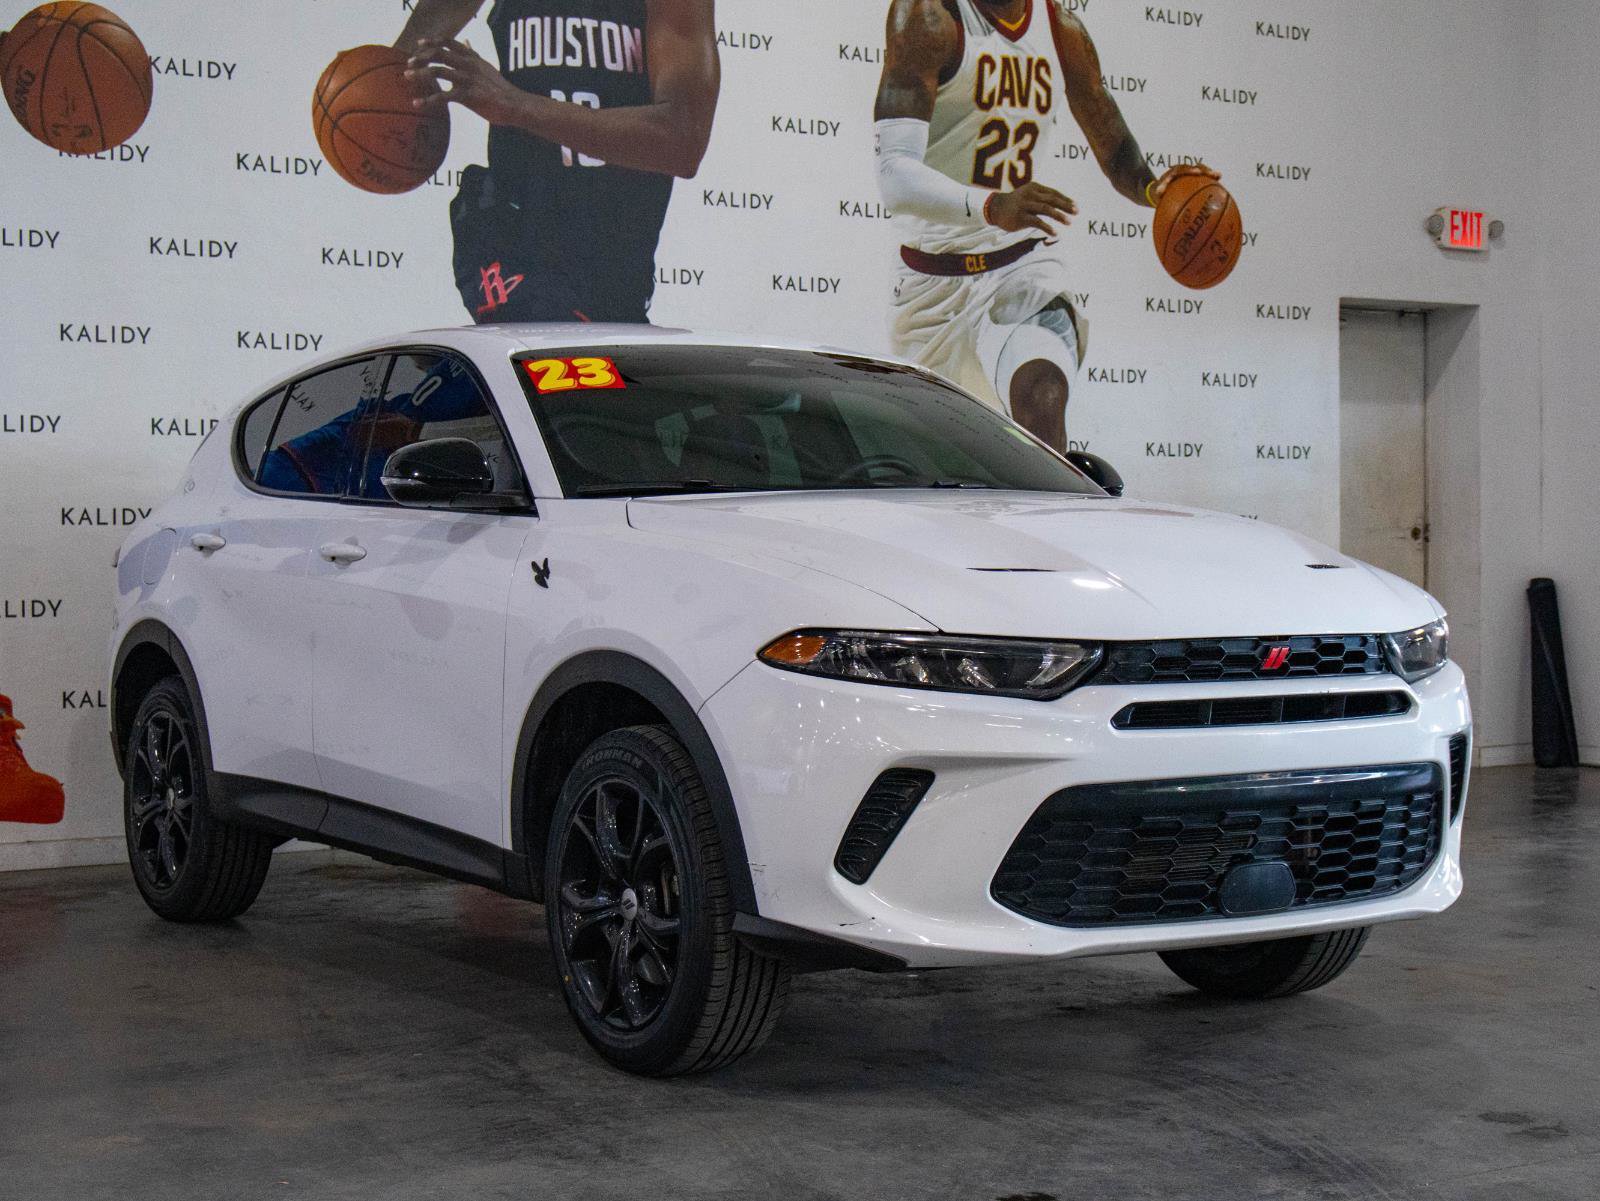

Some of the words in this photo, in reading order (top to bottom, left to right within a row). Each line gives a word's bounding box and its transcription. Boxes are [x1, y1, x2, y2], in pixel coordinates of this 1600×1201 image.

[1145, 7, 1203, 27] KALIDY
[716, 30, 773, 51] ALIDY
[1256, 21, 1310, 42] KALIDY
[508, 16, 644, 74] HOUSTON
[839, 43, 880, 63] KALI
[149, 55, 237, 80] KALIDY
[974, 52, 1052, 116] CAVS
[1101, 75, 1147, 93] ALIDY
[1202, 86, 1257, 105] KALIDY
[772, 115, 841, 137] KALIDY
[972, 116, 1039, 190] 23
[236, 152, 323, 176] KALIDY
[1256, 163, 1311, 181] KALIDY
[703, 189, 774, 210] KALIDY
[2, 227, 60, 249] LIDY
[1088, 220, 1147, 239] KALIDY
[1450, 209, 1484, 250] EXIT
[149, 236, 238, 259] KALIDY
[321, 247, 404, 269] KALIDY
[964, 254, 988, 273] CLE
[660, 267, 704, 286] LIDY
[772, 274, 841, 294] KALIDY
[1146, 297, 1203, 315] KALIDY
[1256, 304, 1311, 321] KALIDY
[60, 323, 151, 345] KALIDY
[237, 330, 323, 352] KALIDY
[528, 357, 616, 390] 23
[1088, 367, 1147, 384] KALIDY
[1202, 372, 1257, 388] KALIDY
[3, 414, 61, 433] LIDY
[1146, 442, 1203, 458] KALIDY
[1256, 445, 1311, 460] KALIDY
[61, 507, 152, 526] KALIDY
[4, 599, 62, 618] LIDY
[62, 690, 107, 709] KAL
